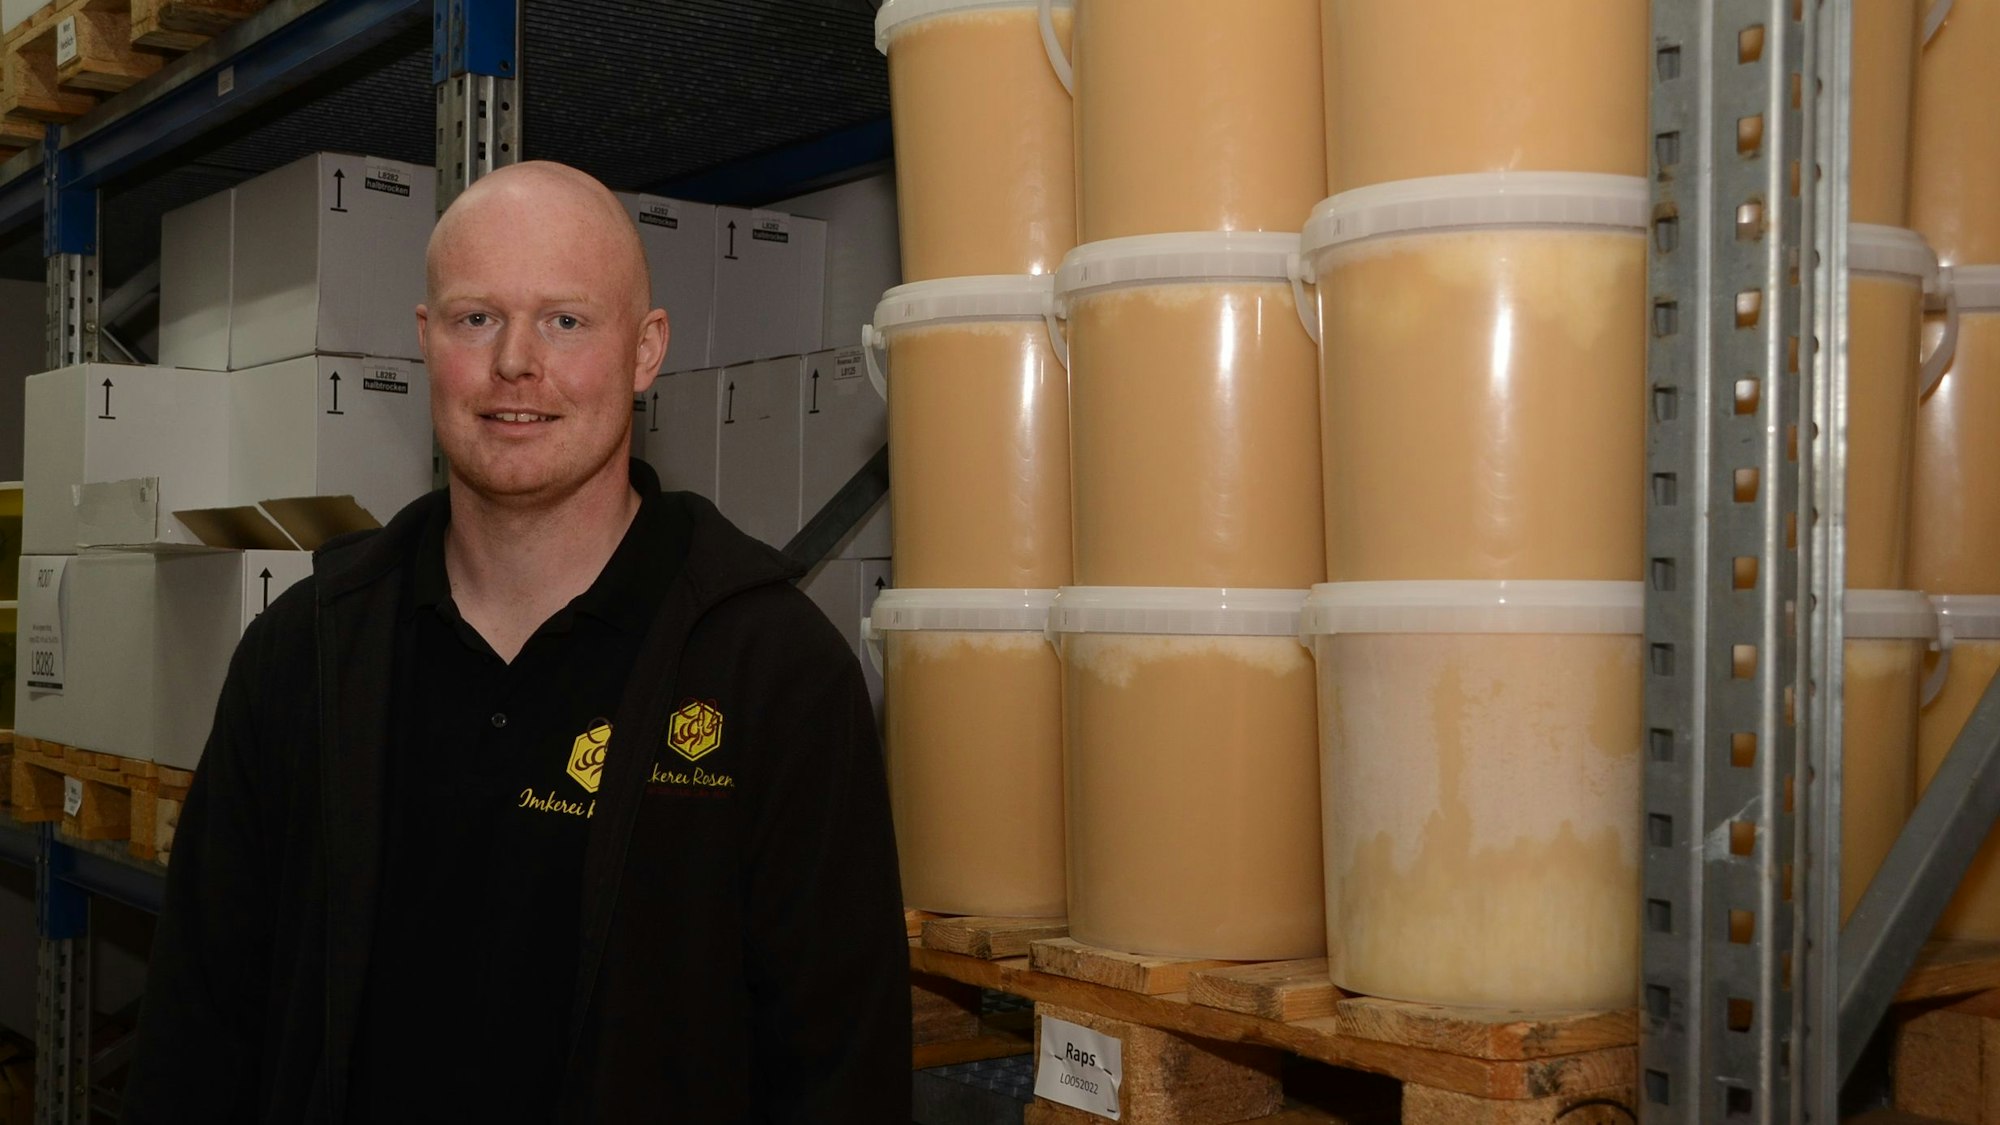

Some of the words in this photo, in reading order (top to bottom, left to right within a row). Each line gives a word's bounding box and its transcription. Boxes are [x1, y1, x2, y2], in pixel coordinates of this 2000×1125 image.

[378, 170, 399, 182] L8282
[367, 179, 408, 195] halbtrocken
[376, 370, 397, 380] L8282
[365, 380, 407, 393] halbtrocken
[32, 650, 54, 676] L8282
[649, 762, 691, 785] kerei
[518, 787, 585, 816] Imkerei
[1066, 1042, 1096, 1068] Raps
